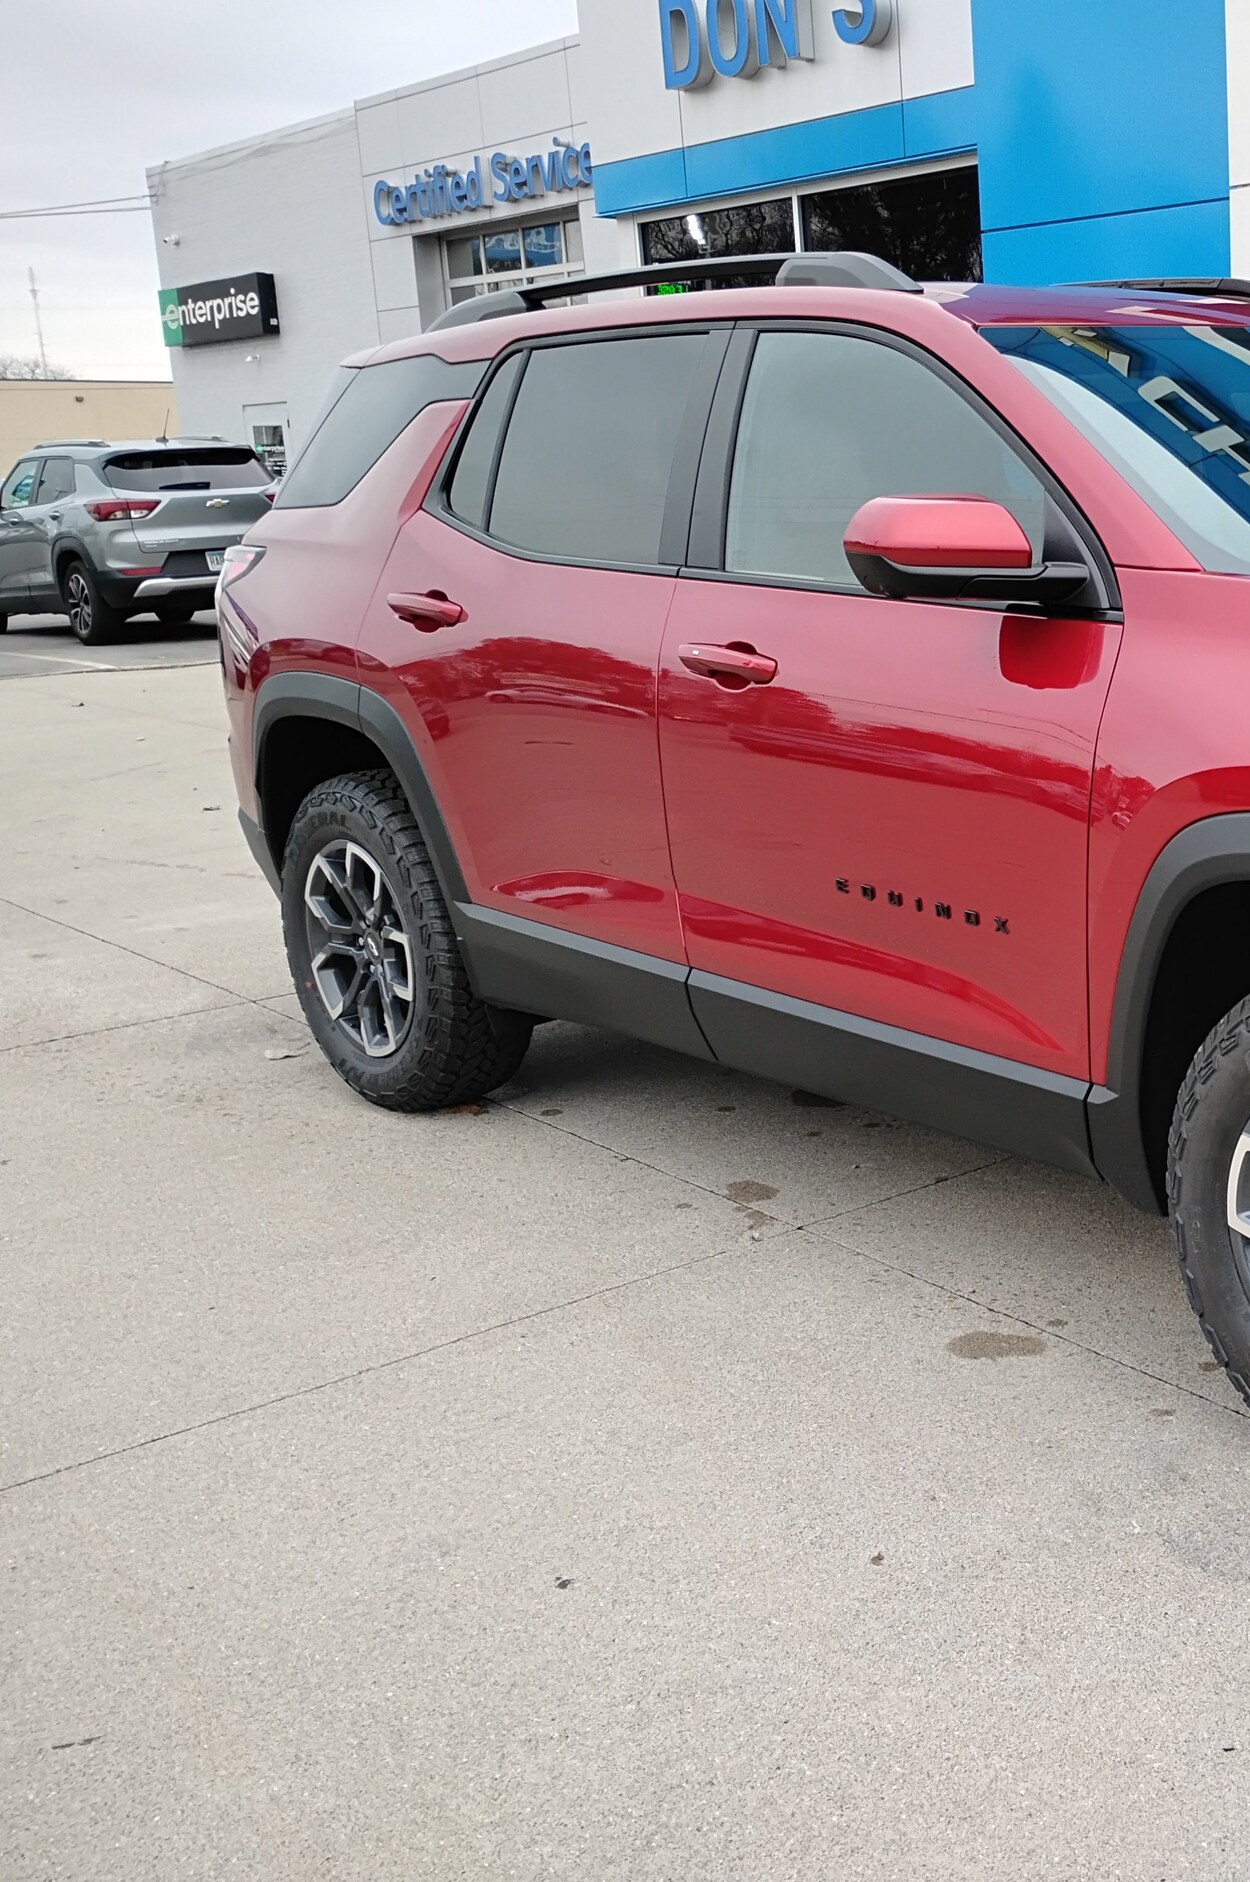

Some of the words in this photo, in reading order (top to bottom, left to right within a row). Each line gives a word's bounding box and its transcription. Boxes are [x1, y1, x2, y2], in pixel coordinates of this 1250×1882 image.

[658, 0, 886, 90] DON
[373, 155, 486, 226] Certified
[489, 136, 593, 203] Service
[160, 287, 260, 330] enterprise
[834, 877, 1011, 935] EQUINOX
